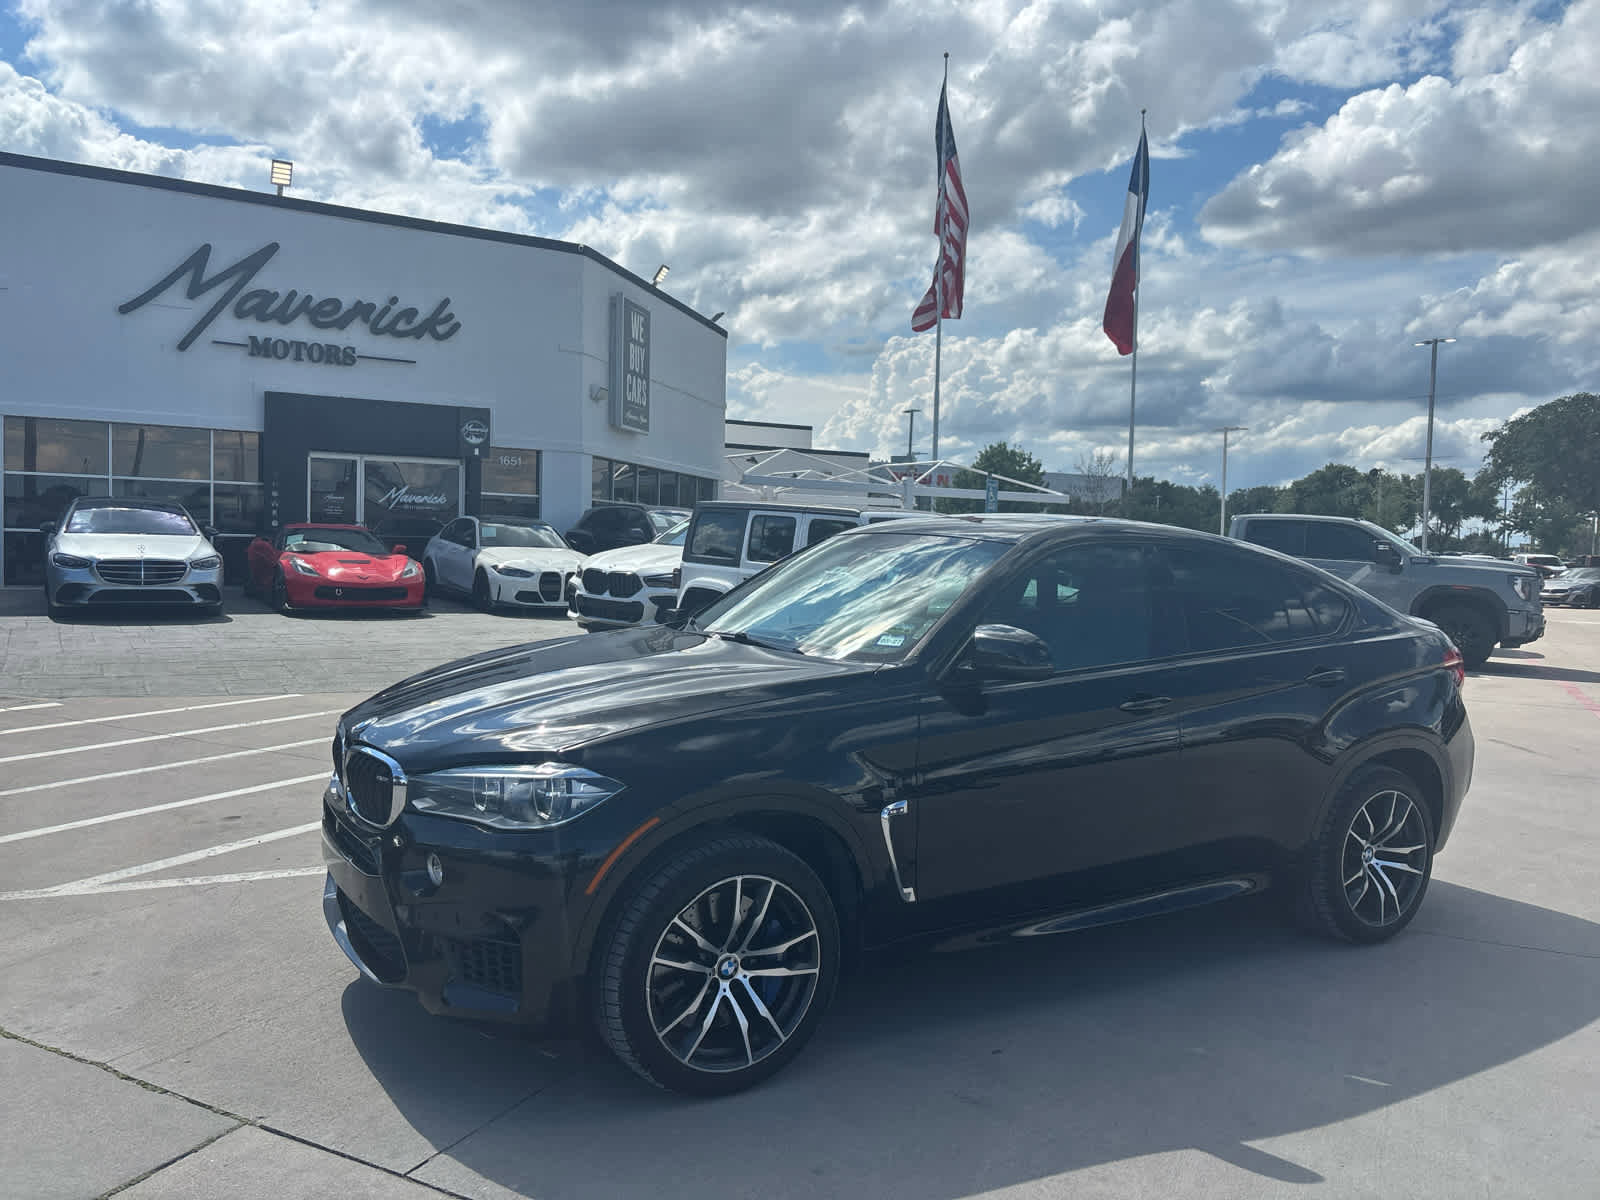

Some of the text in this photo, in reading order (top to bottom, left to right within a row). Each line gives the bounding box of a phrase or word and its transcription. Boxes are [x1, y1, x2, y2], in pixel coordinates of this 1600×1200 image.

[118, 242, 461, 351] Maverick
[631, 311, 645, 342] WE
[248, 336, 357, 366] MOTORS
[629, 343, 645, 374] BUY
[626, 374, 647, 406] CARS
[499, 456, 521, 466] 1651
[378, 484, 448, 511] Maverick
